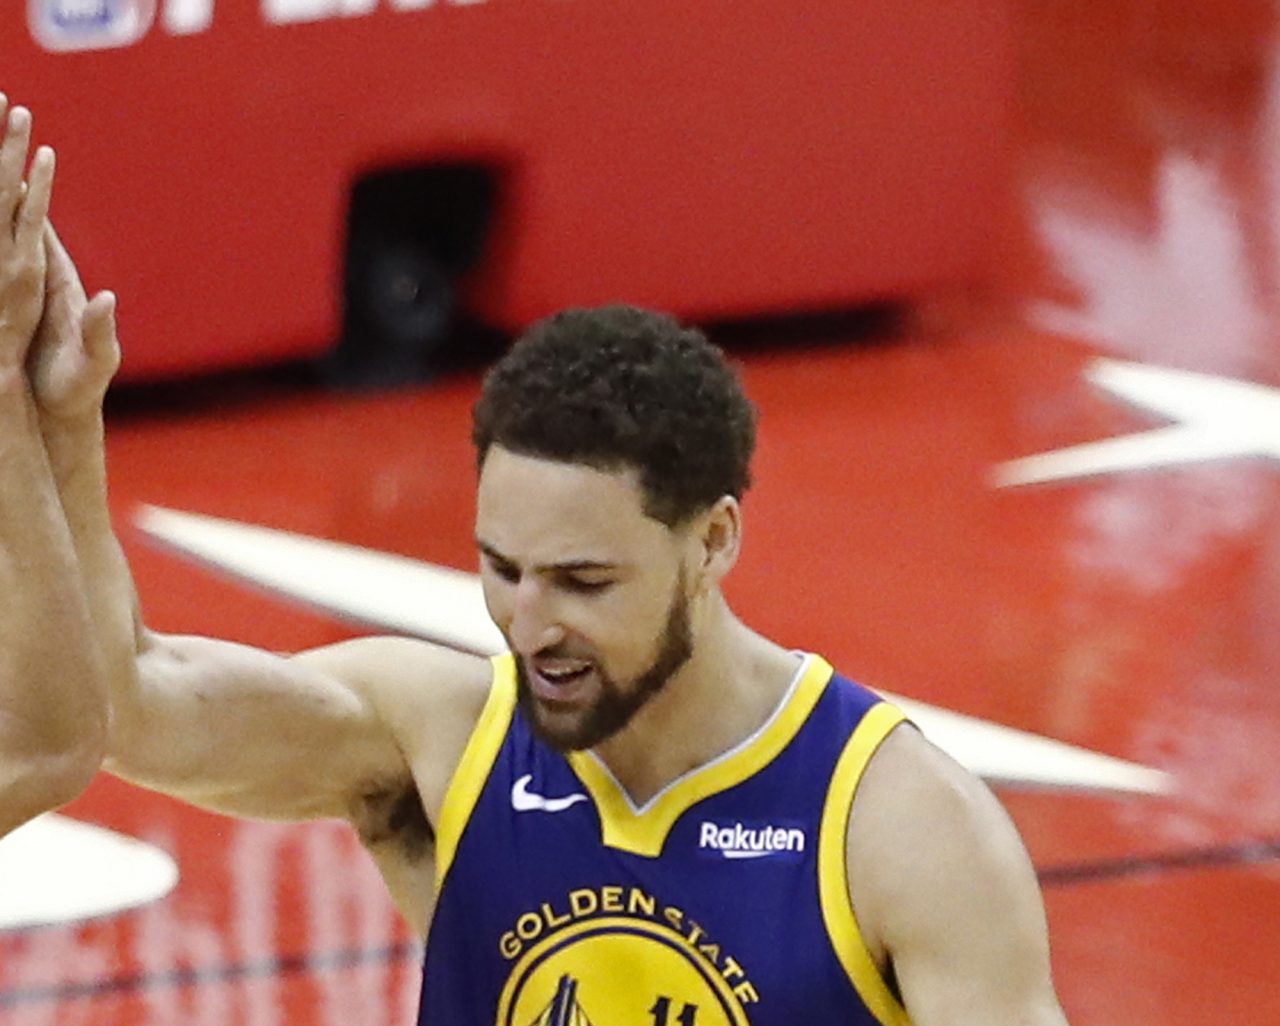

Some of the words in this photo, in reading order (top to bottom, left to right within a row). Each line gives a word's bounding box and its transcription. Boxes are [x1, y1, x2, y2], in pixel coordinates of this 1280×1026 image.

[699, 821, 806, 853] Rakuten
[498, 885, 655, 961] GOLDEN
[663, 905, 760, 1006] STATE
